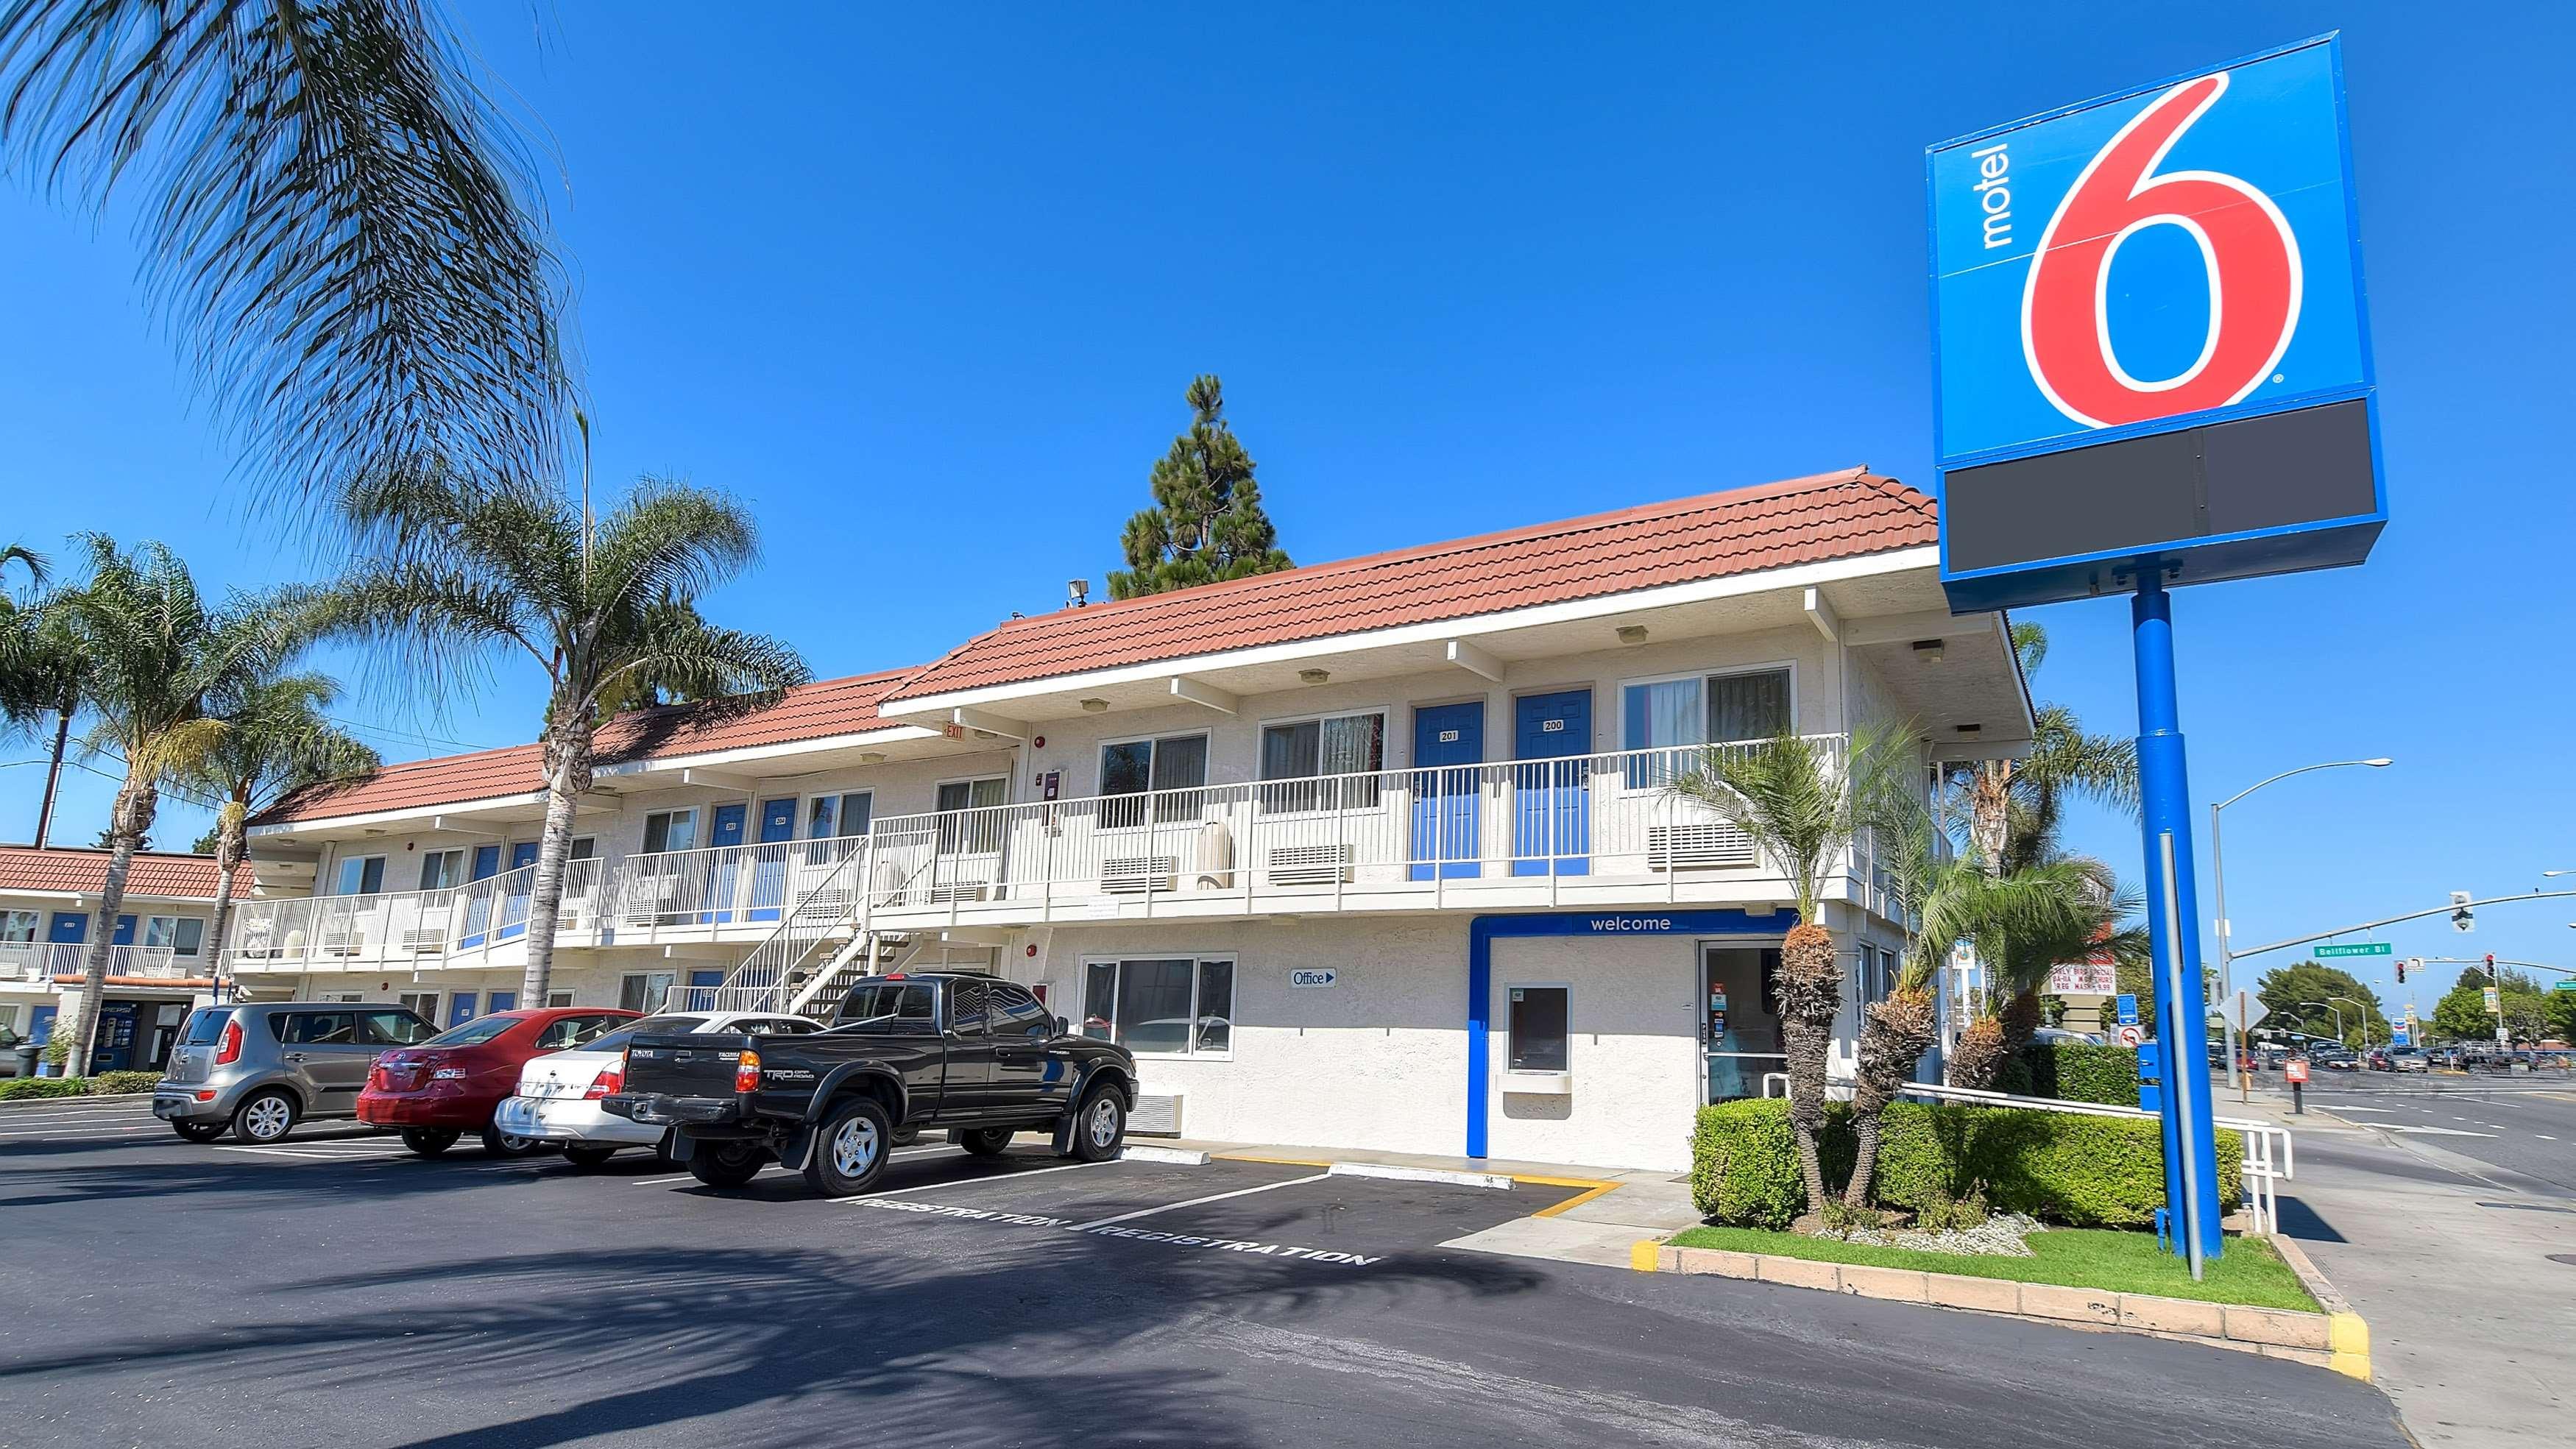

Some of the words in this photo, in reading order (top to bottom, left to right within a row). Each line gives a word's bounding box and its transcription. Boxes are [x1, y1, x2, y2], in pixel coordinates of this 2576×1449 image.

[1972, 143, 2013, 250] motel
[2021, 71, 2304, 429] 6
[947, 725, 966, 738] EXIT
[1546, 720, 1562, 730] 200
[1442, 731, 1456, 740] 201
[1591, 916, 1671, 930] welcome
[2319, 946, 2369, 955] Bellflower
[1293, 971, 1324, 985] Office
[631, 1049, 654, 1058] TOYOTA
[763, 1069, 793, 1080] TRD
[846, 1198, 1073, 1227] REGISTRATION
[1087, 1225, 1382, 1266] REGISTRATION
